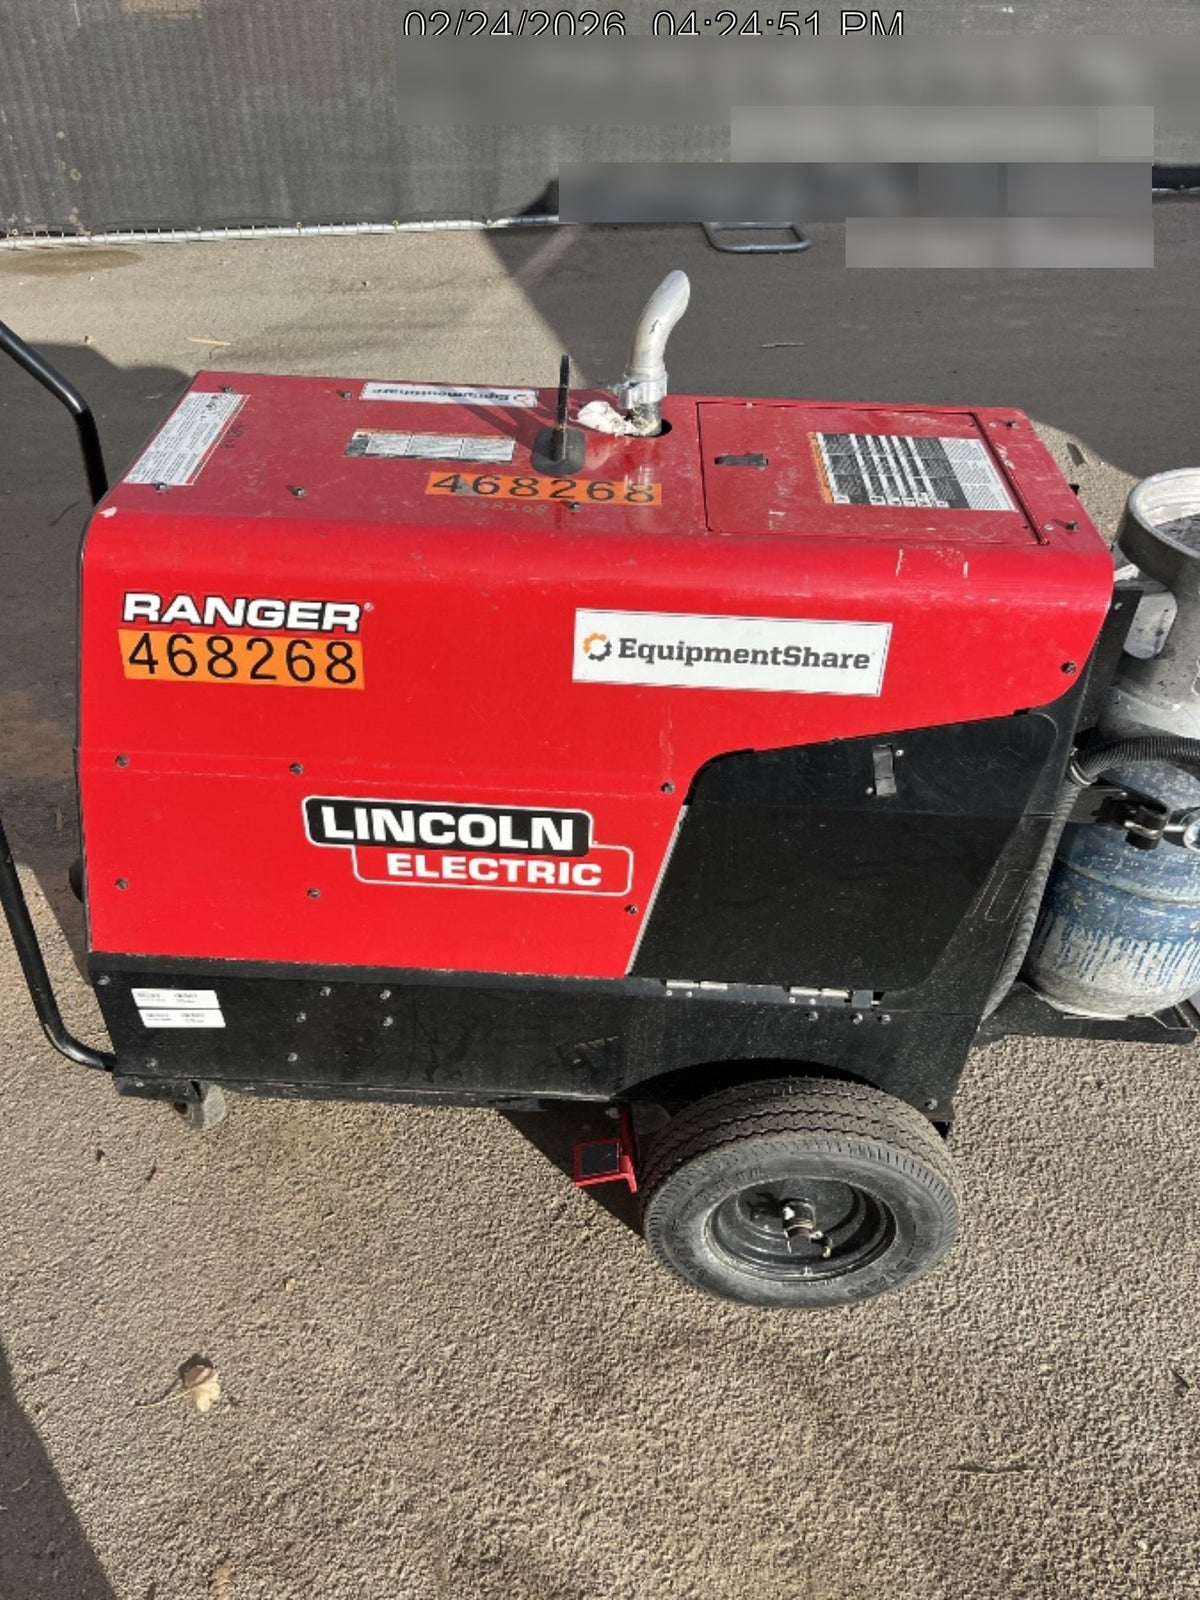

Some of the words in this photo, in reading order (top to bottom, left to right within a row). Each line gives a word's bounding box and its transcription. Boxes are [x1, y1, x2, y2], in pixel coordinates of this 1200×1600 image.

[432, 473, 655, 503] 468268
[122, 591, 362, 634] RANGER
[128, 632, 357, 685] 468268
[617, 637, 871, 670] EquipmentShare
[321, 805, 575, 851] LINCOLN
[386, 852, 603, 887] ELECTRIC
